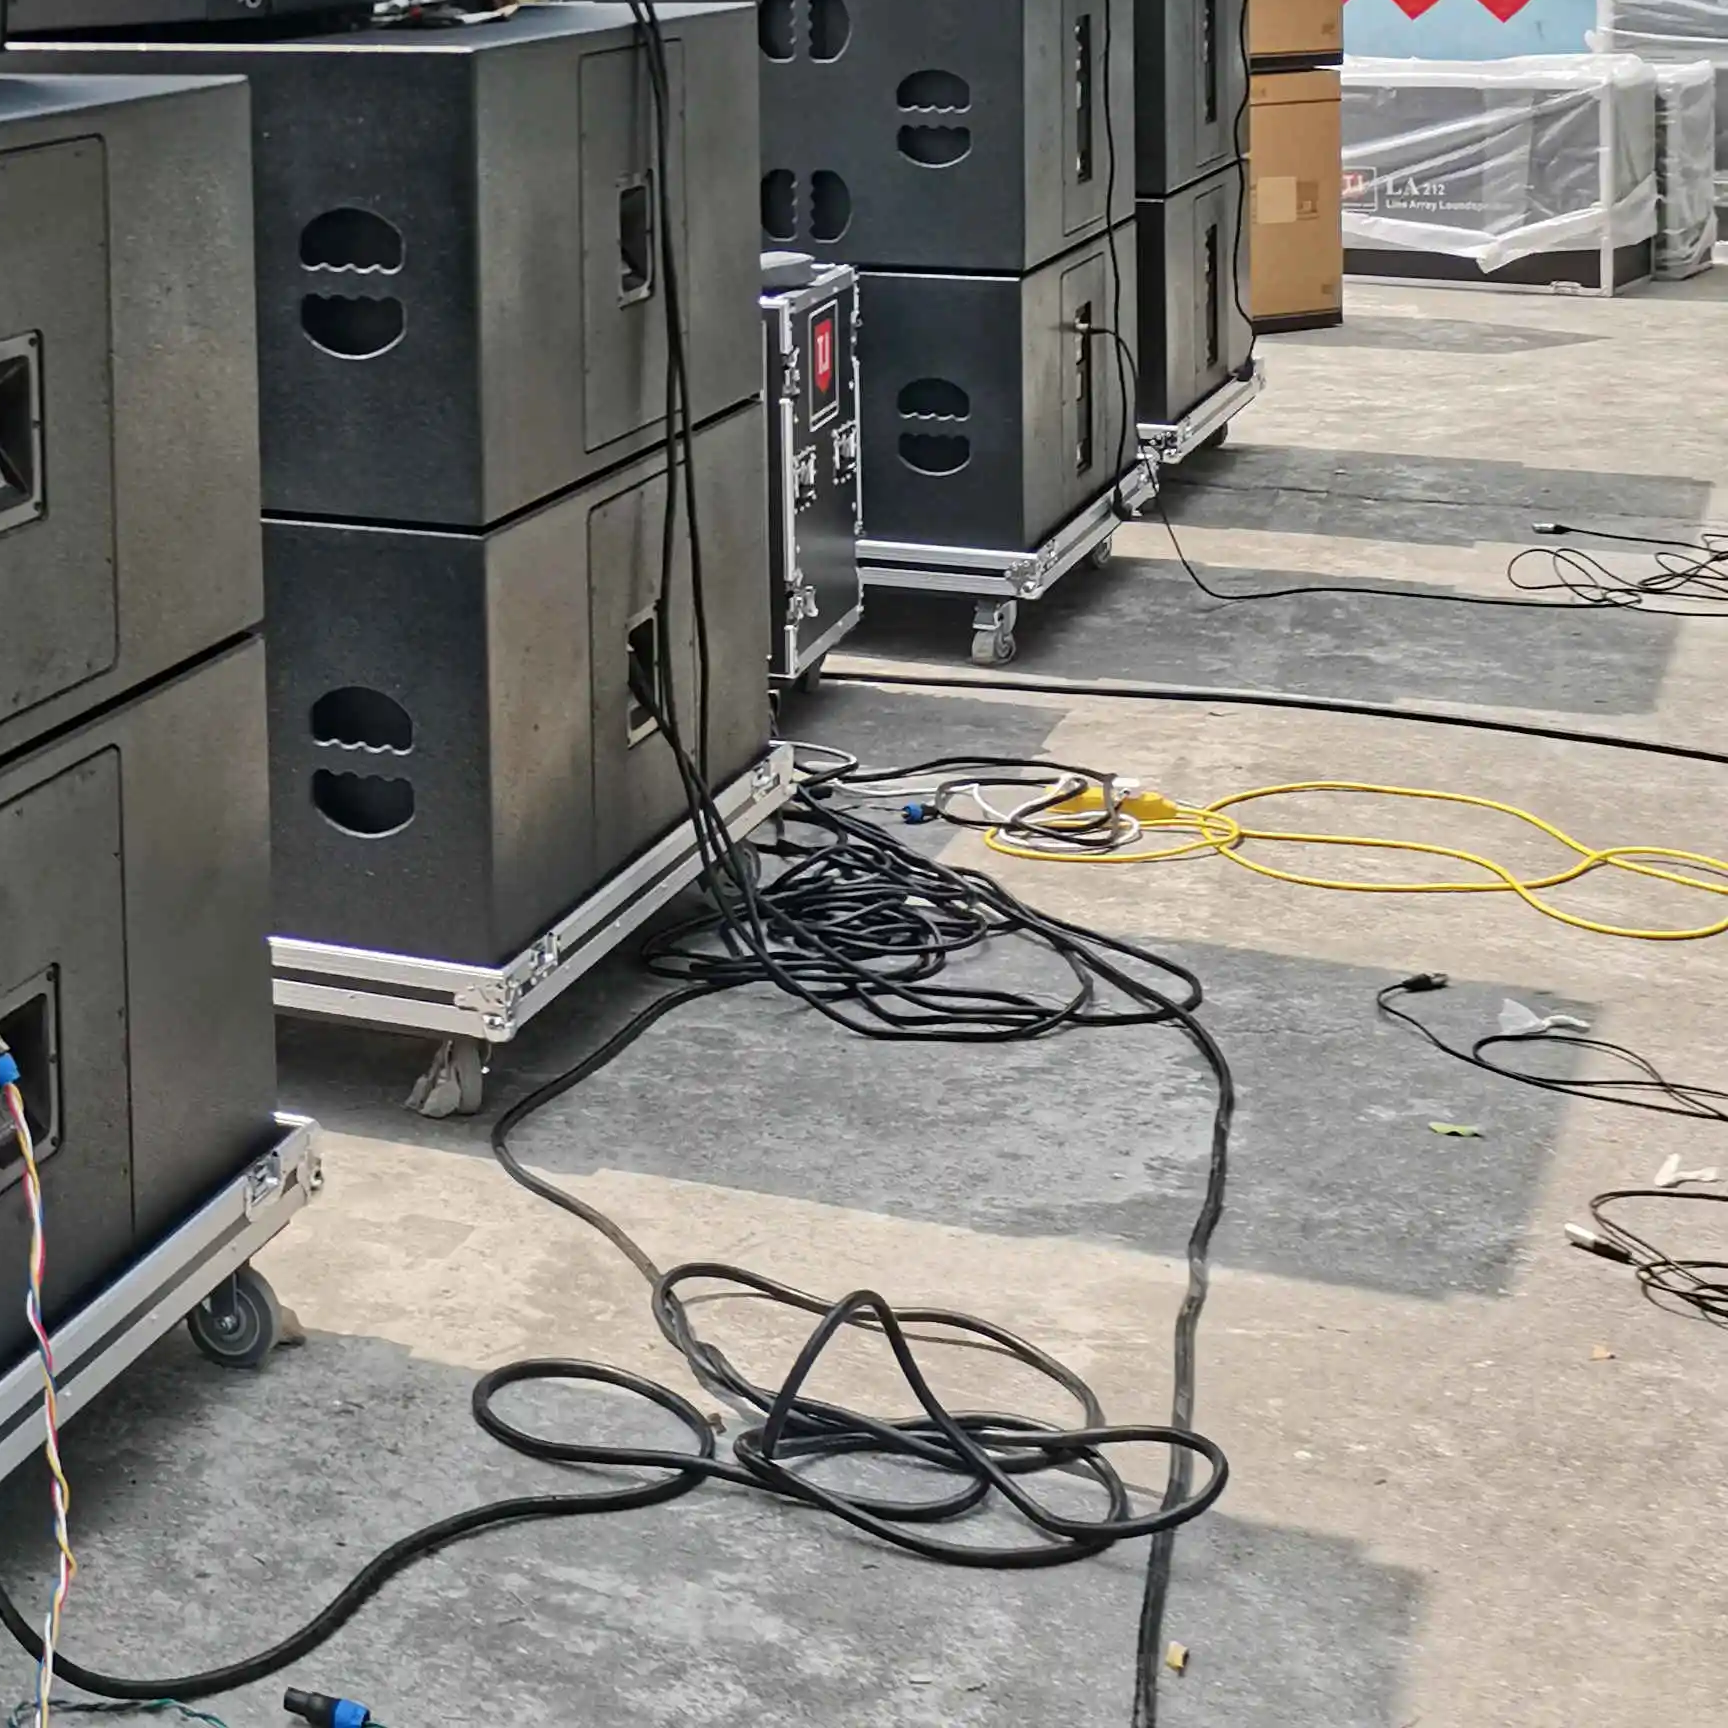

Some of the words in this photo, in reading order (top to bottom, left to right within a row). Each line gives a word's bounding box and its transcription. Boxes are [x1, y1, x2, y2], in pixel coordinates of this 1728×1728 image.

[1385, 177, 1420, 196] LA
[1423, 183, 1446, 196] 212
[1409, 200, 1437, 212] Array
